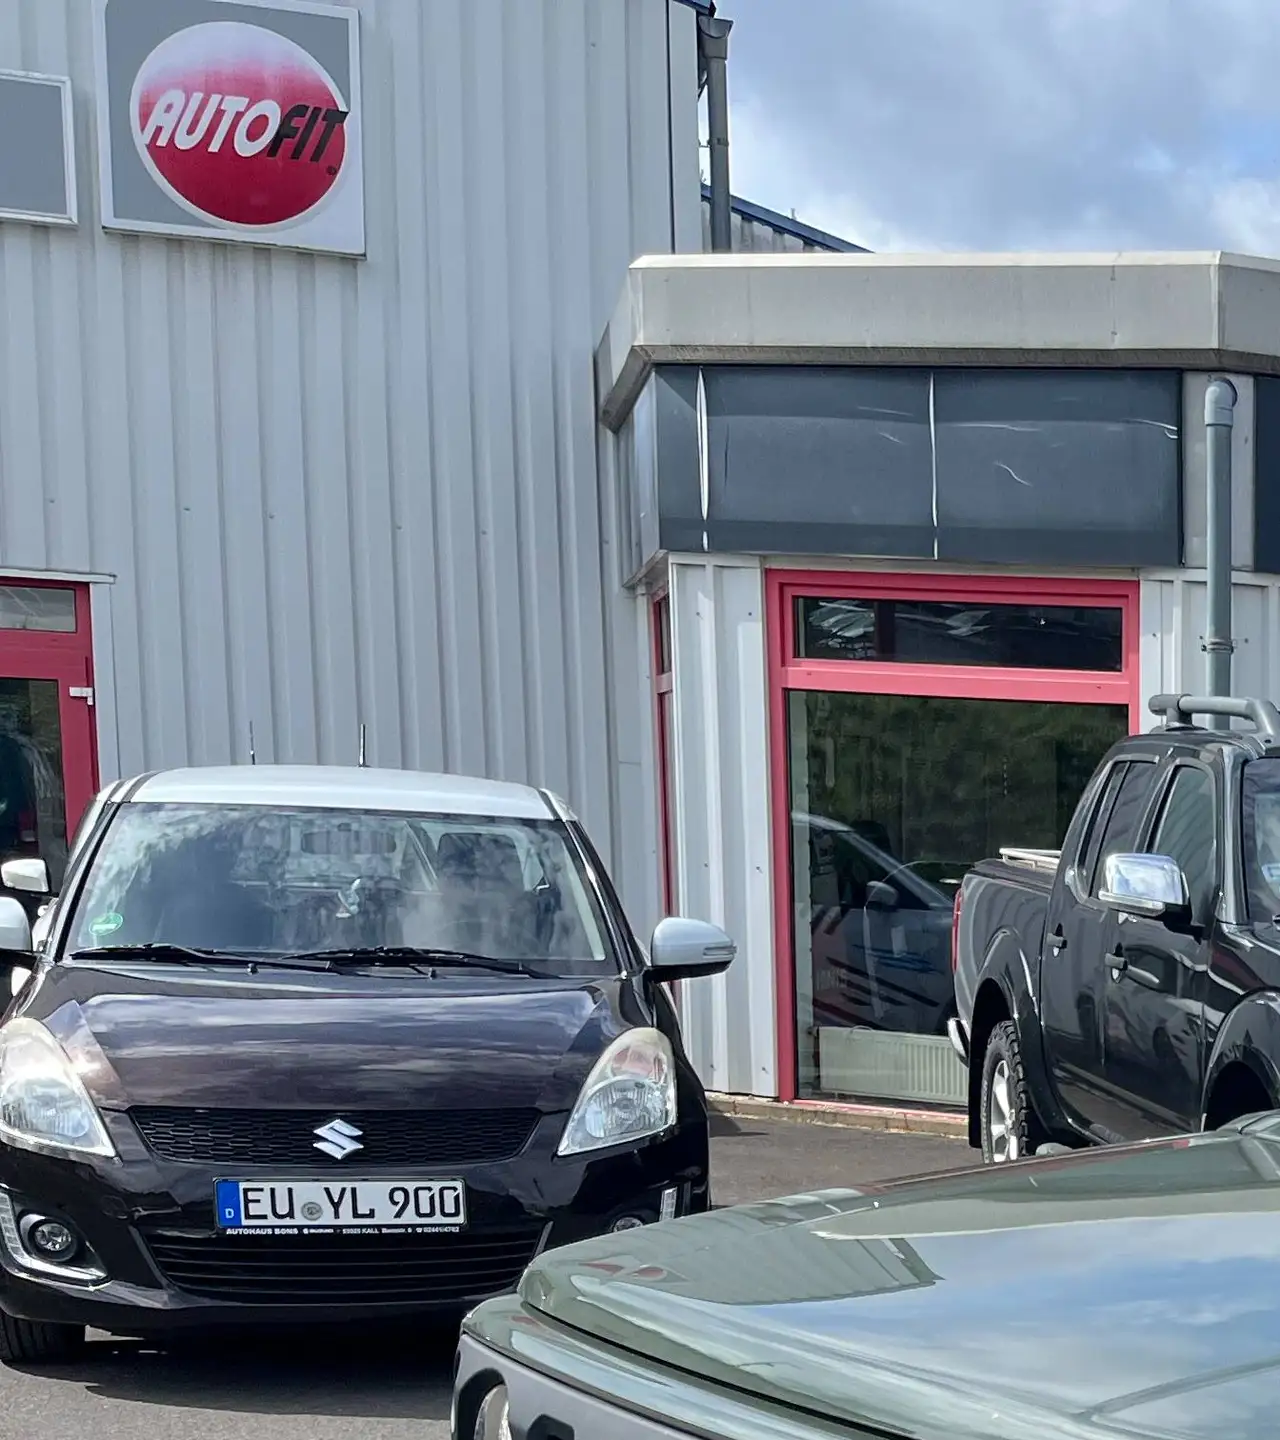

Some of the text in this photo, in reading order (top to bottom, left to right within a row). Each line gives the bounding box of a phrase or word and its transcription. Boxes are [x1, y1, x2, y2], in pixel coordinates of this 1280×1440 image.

[143, 89, 349, 162] AUTOFIT
[225, 1208, 234, 1218] D
[243, 1186, 461, 1220] EU YL 900
